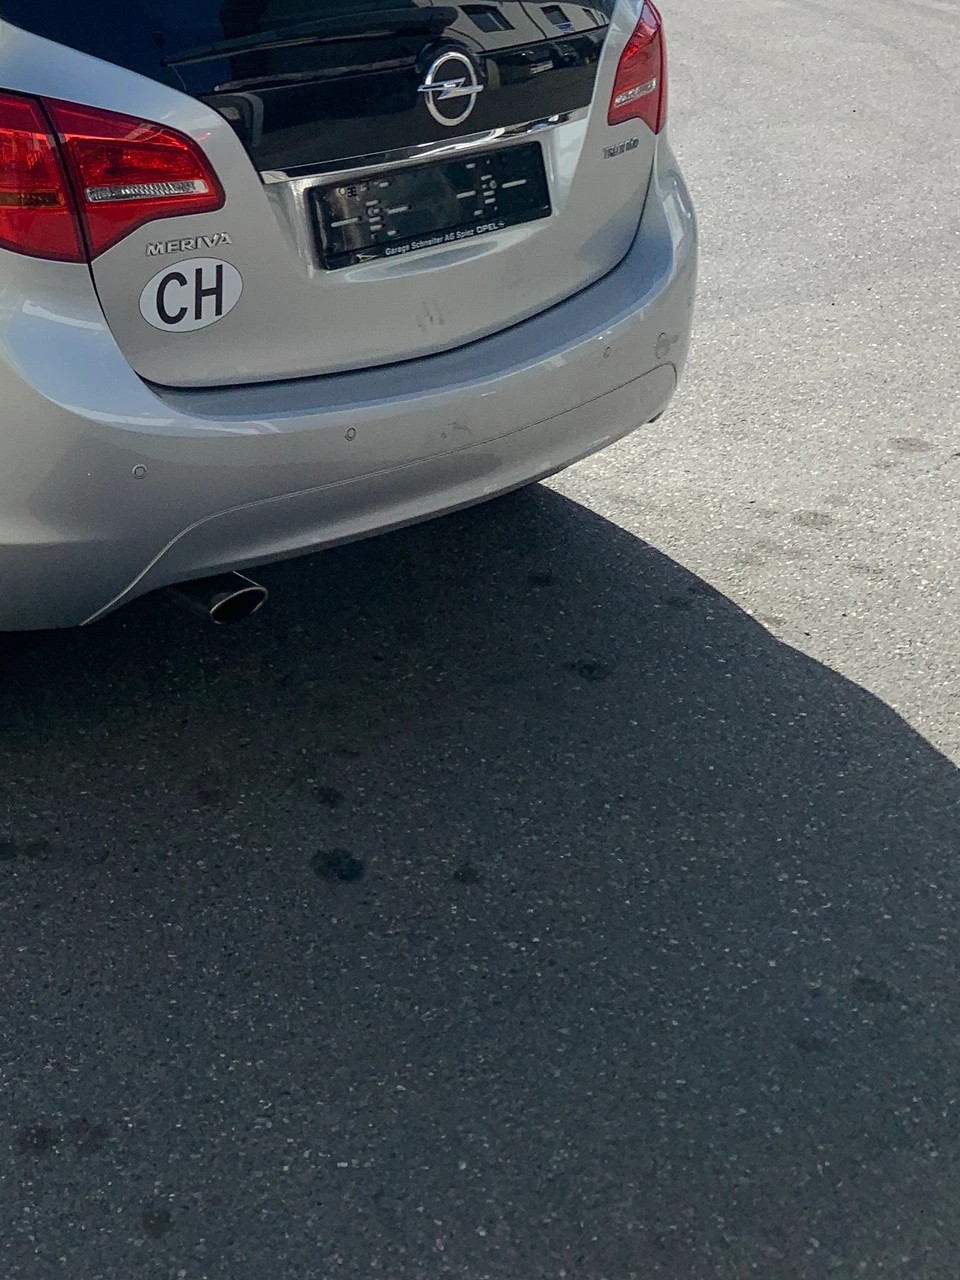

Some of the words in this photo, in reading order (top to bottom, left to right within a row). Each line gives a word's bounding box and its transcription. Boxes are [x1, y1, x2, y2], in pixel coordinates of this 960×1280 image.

[146, 232, 232, 256] MERIVA
[385, 243, 410, 256] Garage
[444, 232, 455, 242] AG
[456, 229, 474, 240] Spiez
[476, 223, 499, 234] OPEL
[156, 264, 223, 324] CH
